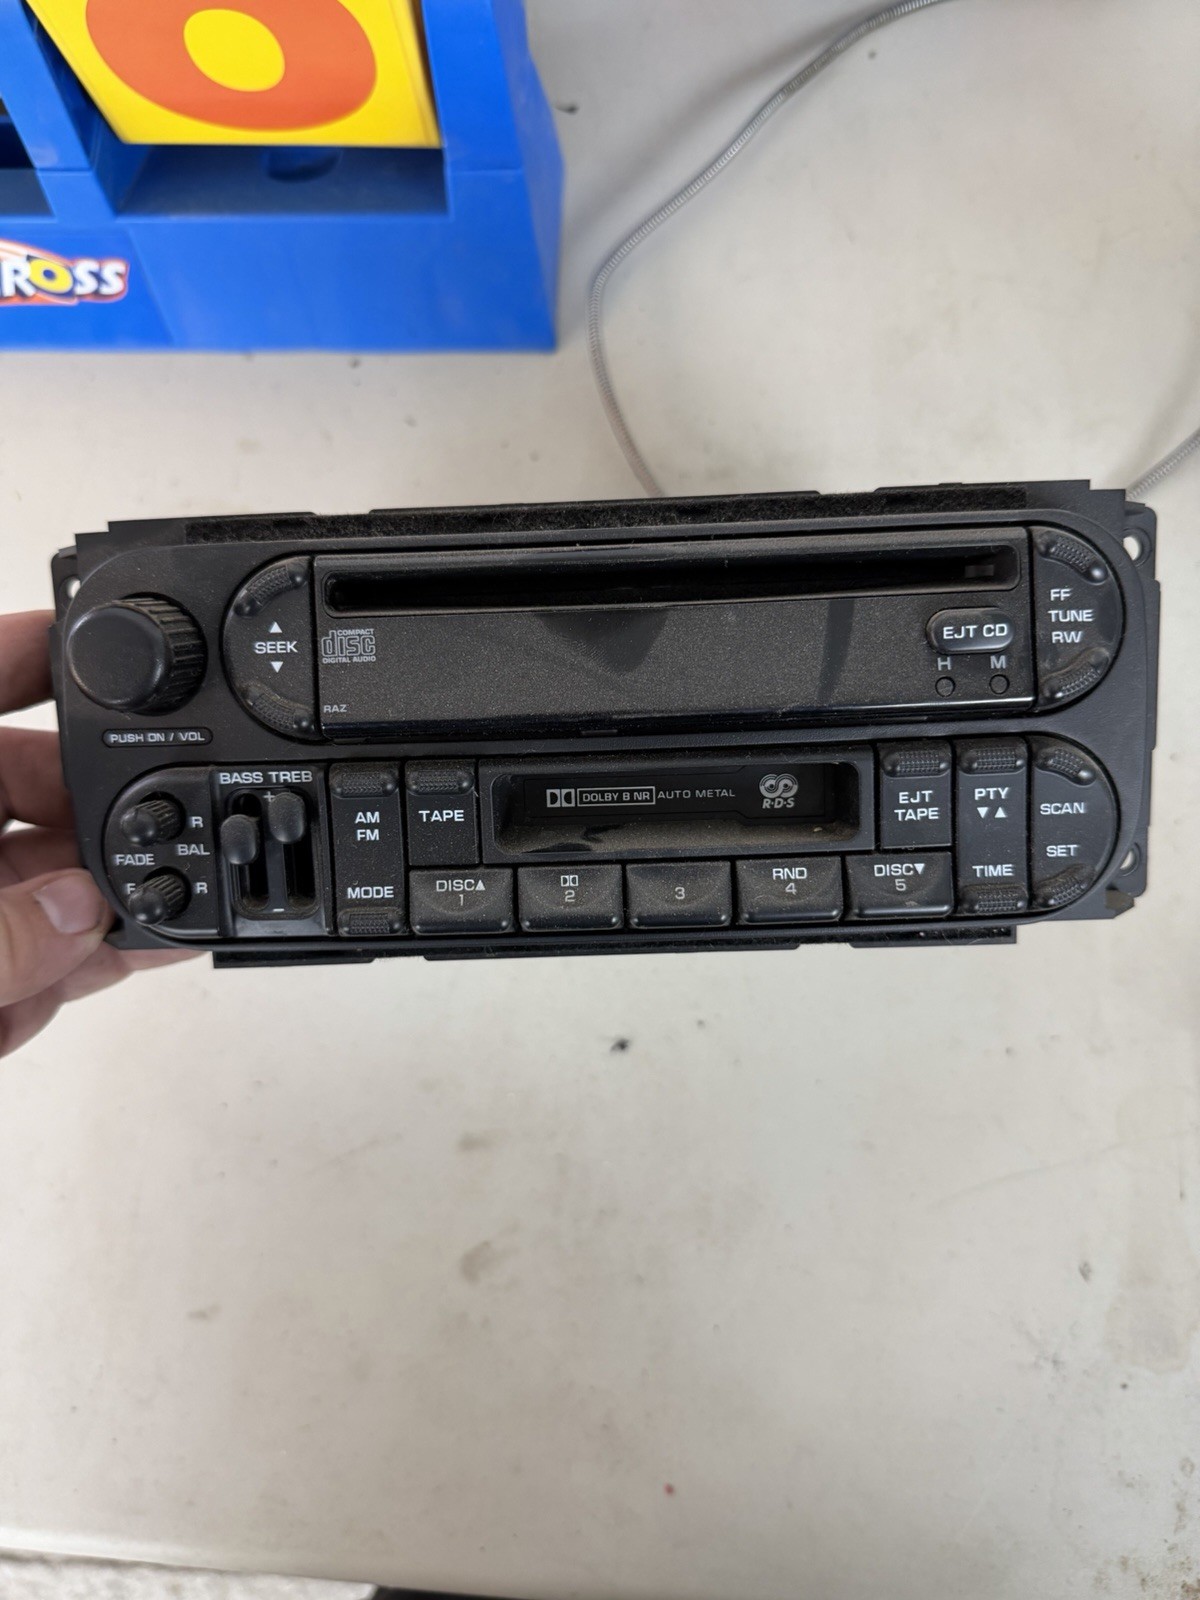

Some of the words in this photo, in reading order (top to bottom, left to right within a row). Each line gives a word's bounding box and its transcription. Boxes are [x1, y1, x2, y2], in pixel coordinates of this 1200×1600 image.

[1050, 588, 1072, 601] FF
[1048, 609, 1094, 623] TUNE
[337, 628, 375, 636] COMPACT
[943, 625, 977, 640] EJT
[982, 623, 1008, 638] CD
[1051, 631, 1083, 644] RW
[254, 640, 299, 655] SEEK
[322, 656, 351, 664] DIGITAL
[352, 655, 377, 663] AUDIO
[937, 656, 952, 671] H
[990, 655, 1007, 669] M
[322, 703, 348, 714] RAZ
[109, 733, 144, 744] PUSH
[147, 732, 166, 743] ON
[180, 731, 206, 742] VOL
[219, 771, 264, 785] BASS
[269, 770, 314, 783] TREB
[582, 791, 619, 803] DOLBY
[622, 791, 630, 802] B
[633, 790, 651, 801] NR
[657, 788, 692, 800] AUTO
[695, 788, 736, 799] METAL
[898, 790, 933, 804] EJT
[974, 787, 1010, 801] PTY
[418, 809, 465, 823] TAPE
[894, 808, 940, 821] TAPE
[1040, 802, 1086, 816] SCAN
[190, 815, 204, 829] R
[355, 811, 381, 824] AM
[356, 828, 380, 841] FM
[177, 843, 210, 856] BAL
[1046, 844, 1079, 857] SET
[115, 853, 156, 866] FADE
[772, 867, 808, 881] RND
[873, 864, 914, 877] DISC
[972, 863, 1015, 877] TIME
[195, 881, 209, 895] R
[435, 878, 476, 893] DISC
[784, 882, 798, 895] 4
[894, 878, 907, 892] 5
[347, 886, 395, 899] MODE
[564, 889, 576, 903] 2
[674, 886, 687, 900] 3
[458, 893, 466, 907] 1
